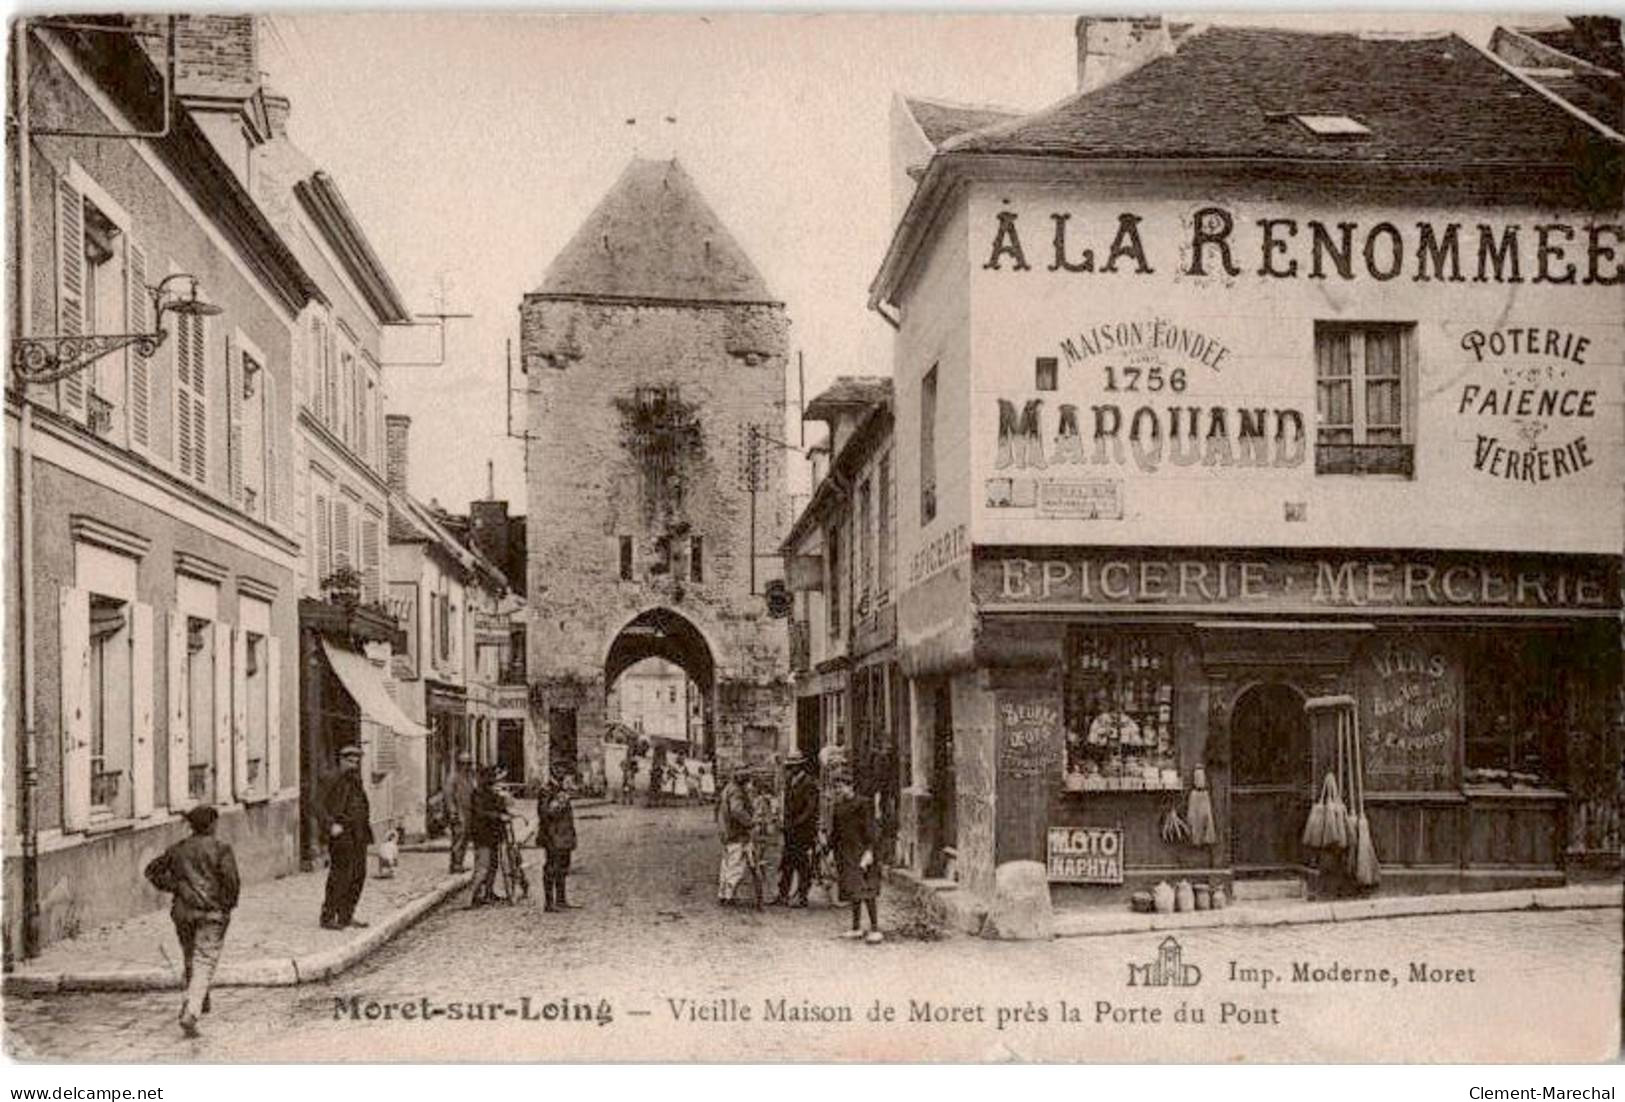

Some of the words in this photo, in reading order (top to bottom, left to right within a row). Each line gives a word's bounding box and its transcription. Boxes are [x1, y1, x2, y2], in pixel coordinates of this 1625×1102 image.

[1048, 212, 1154, 275] LA
[1060, 322, 1142, 368] MAISON
[1461, 328, 1591, 365] POTERIE
[1104, 366, 1187, 392] 1756
[994, 398, 1307, 472] MARQUAND
[1474, 434, 1594, 484] VERRERIE
[1001, 558, 1270, 600] EPICERIE
[1312, 560, 1604, 606] MERCERIE
